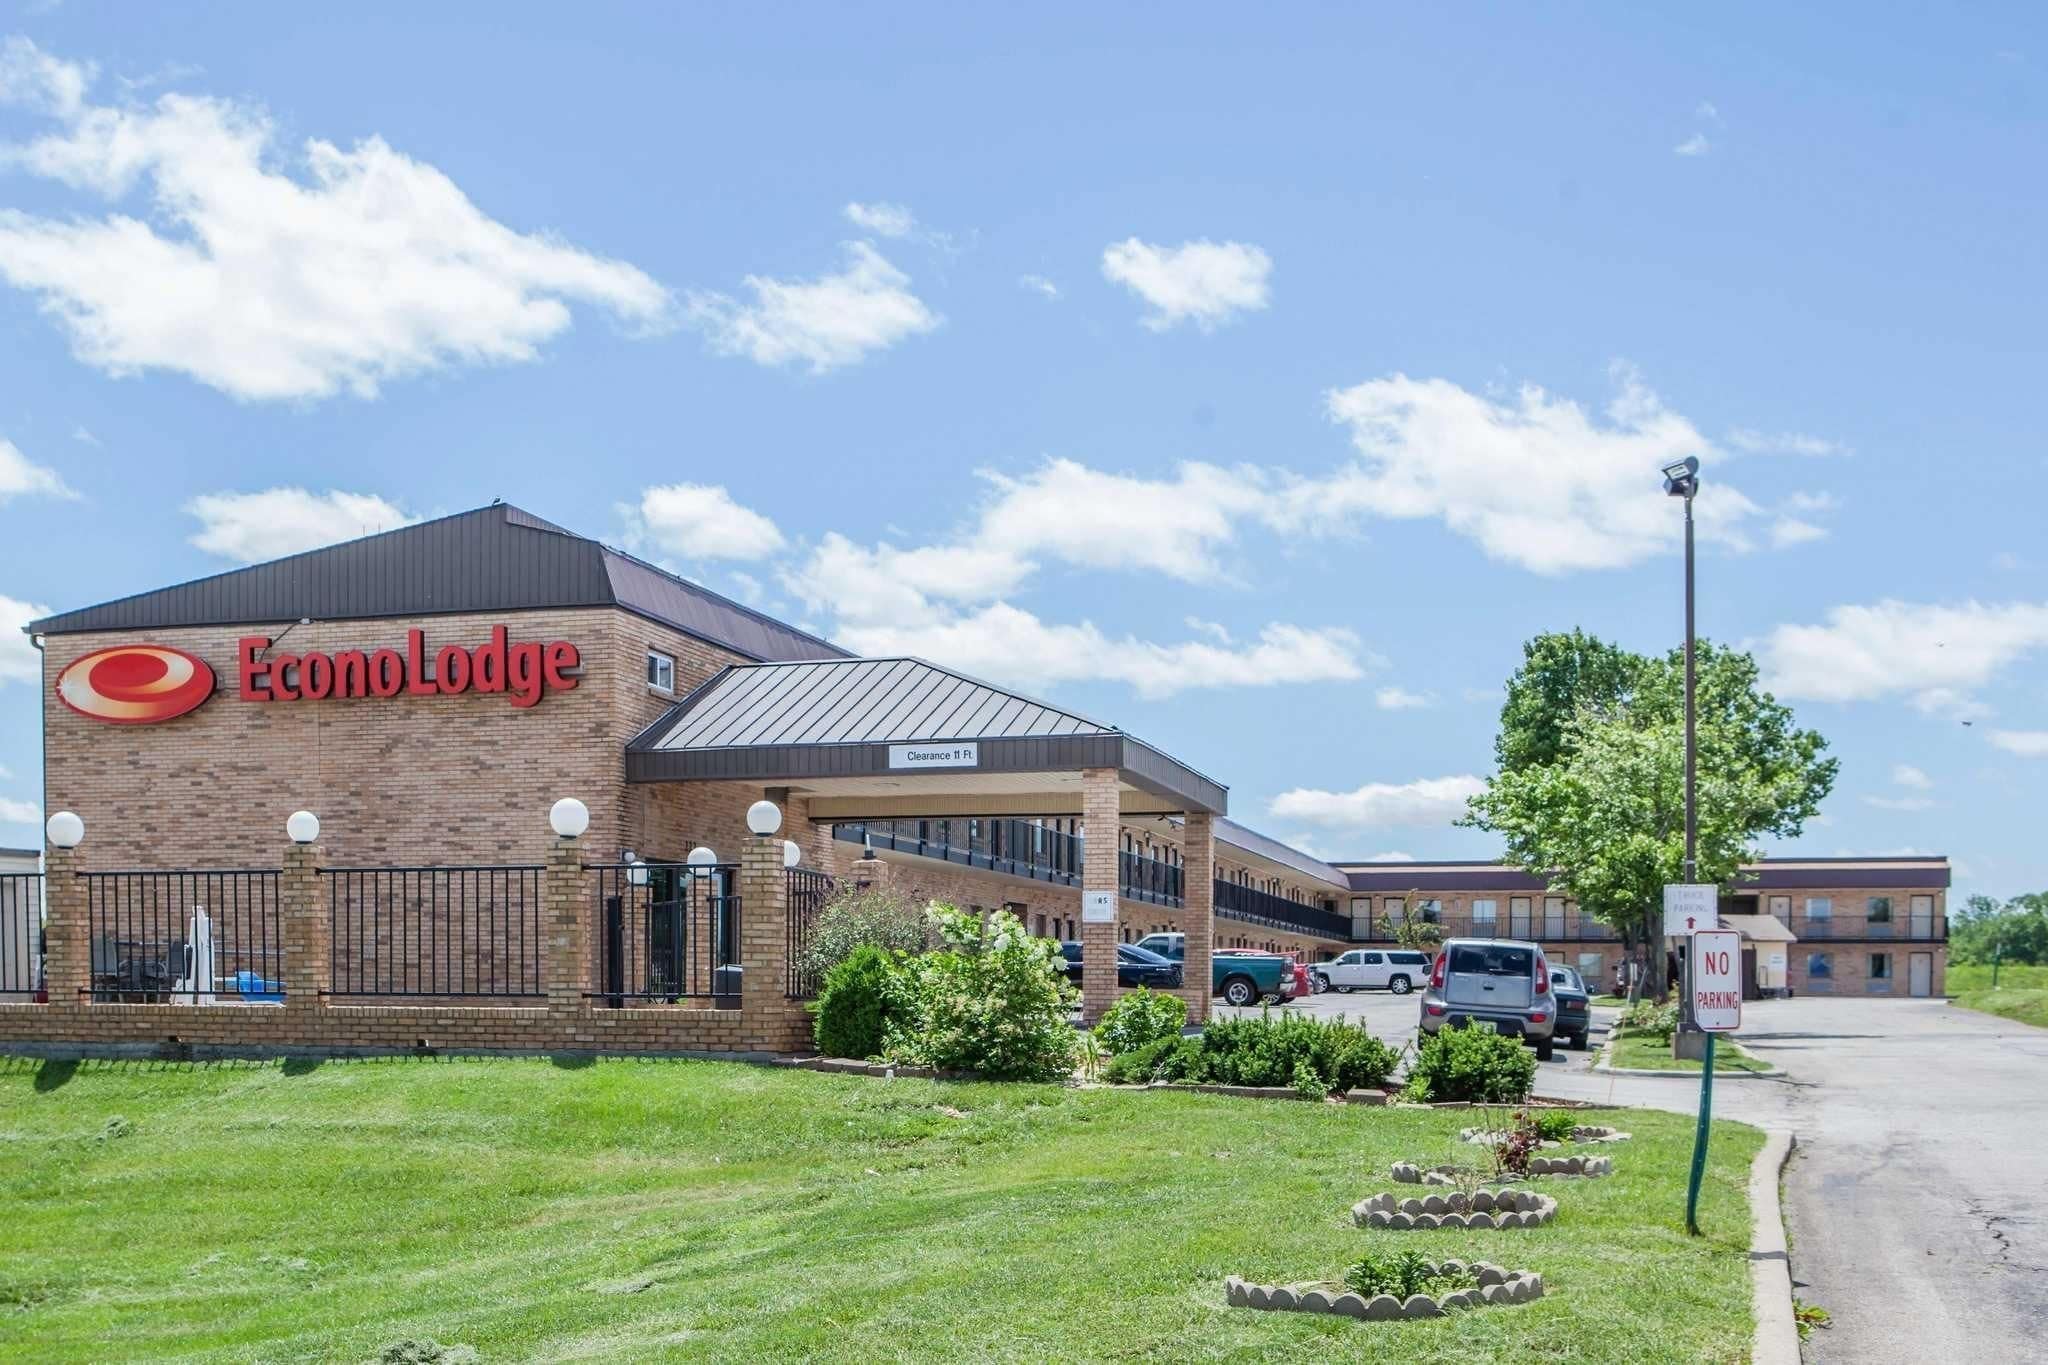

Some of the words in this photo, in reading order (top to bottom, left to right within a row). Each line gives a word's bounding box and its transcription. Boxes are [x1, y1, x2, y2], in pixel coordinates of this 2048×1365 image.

[239, 624, 580, 708] EconoLodge
[907, 751, 951, 761] Clearance
[954, 750, 960, 759] 11
[1705, 951, 1729, 975] NO
[1697, 991, 1738, 1009] PARKING
